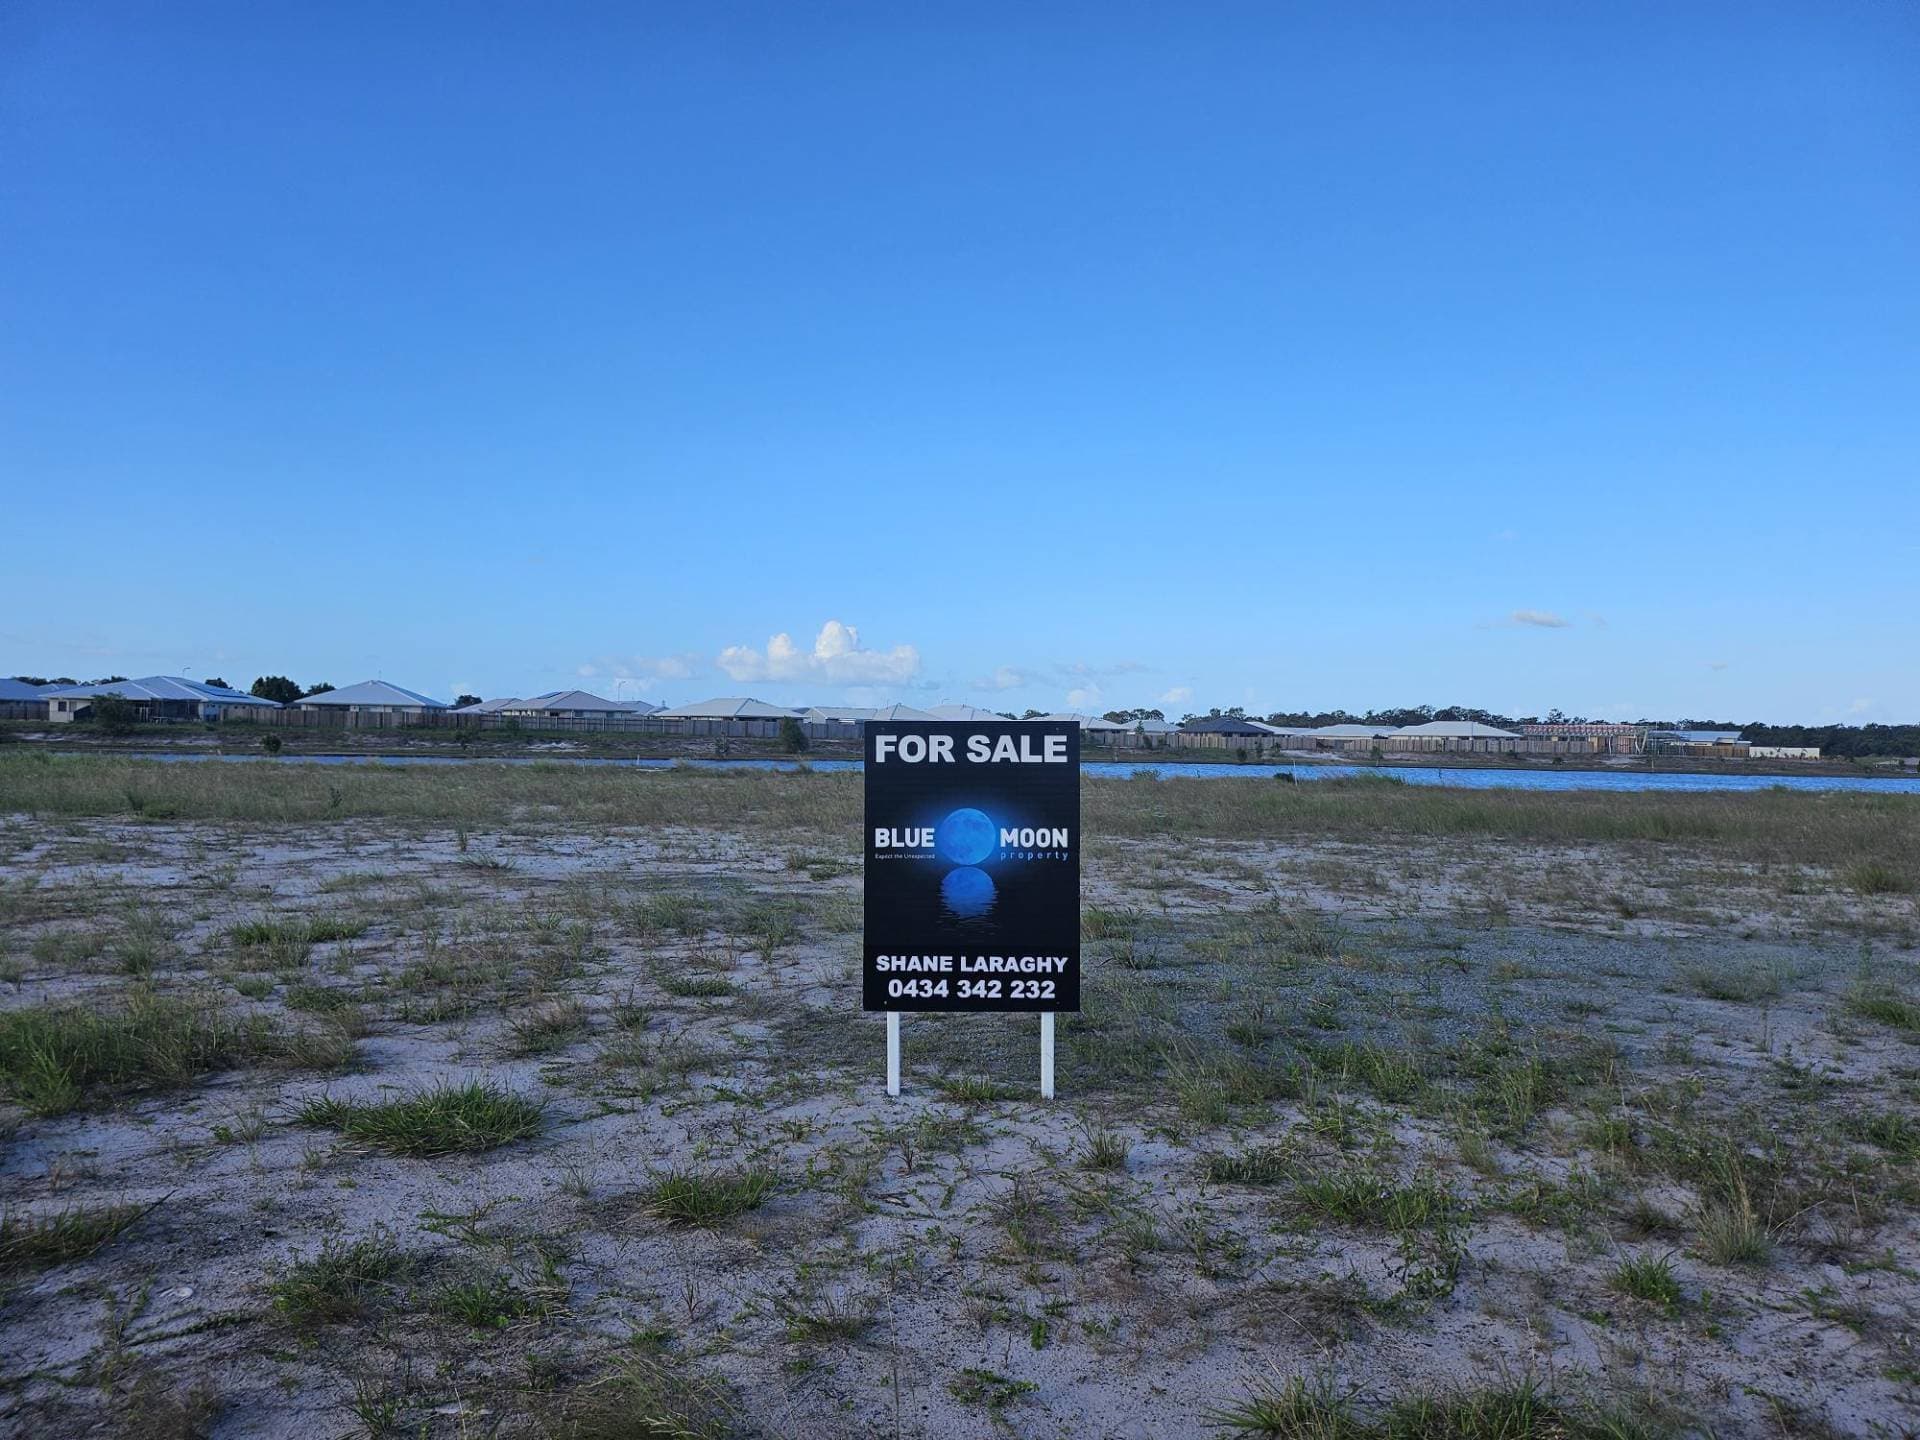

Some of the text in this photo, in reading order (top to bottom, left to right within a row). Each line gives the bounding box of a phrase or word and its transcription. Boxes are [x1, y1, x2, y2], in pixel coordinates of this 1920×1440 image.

[875, 734, 1068, 763] FOR SALE
[875, 828, 1068, 848] BLUE MOON
[1000, 851, 1068, 861] property
[876, 955, 1068, 973] SHANE LARAGHY
[888, 979, 1055, 999] 0434 342 232
